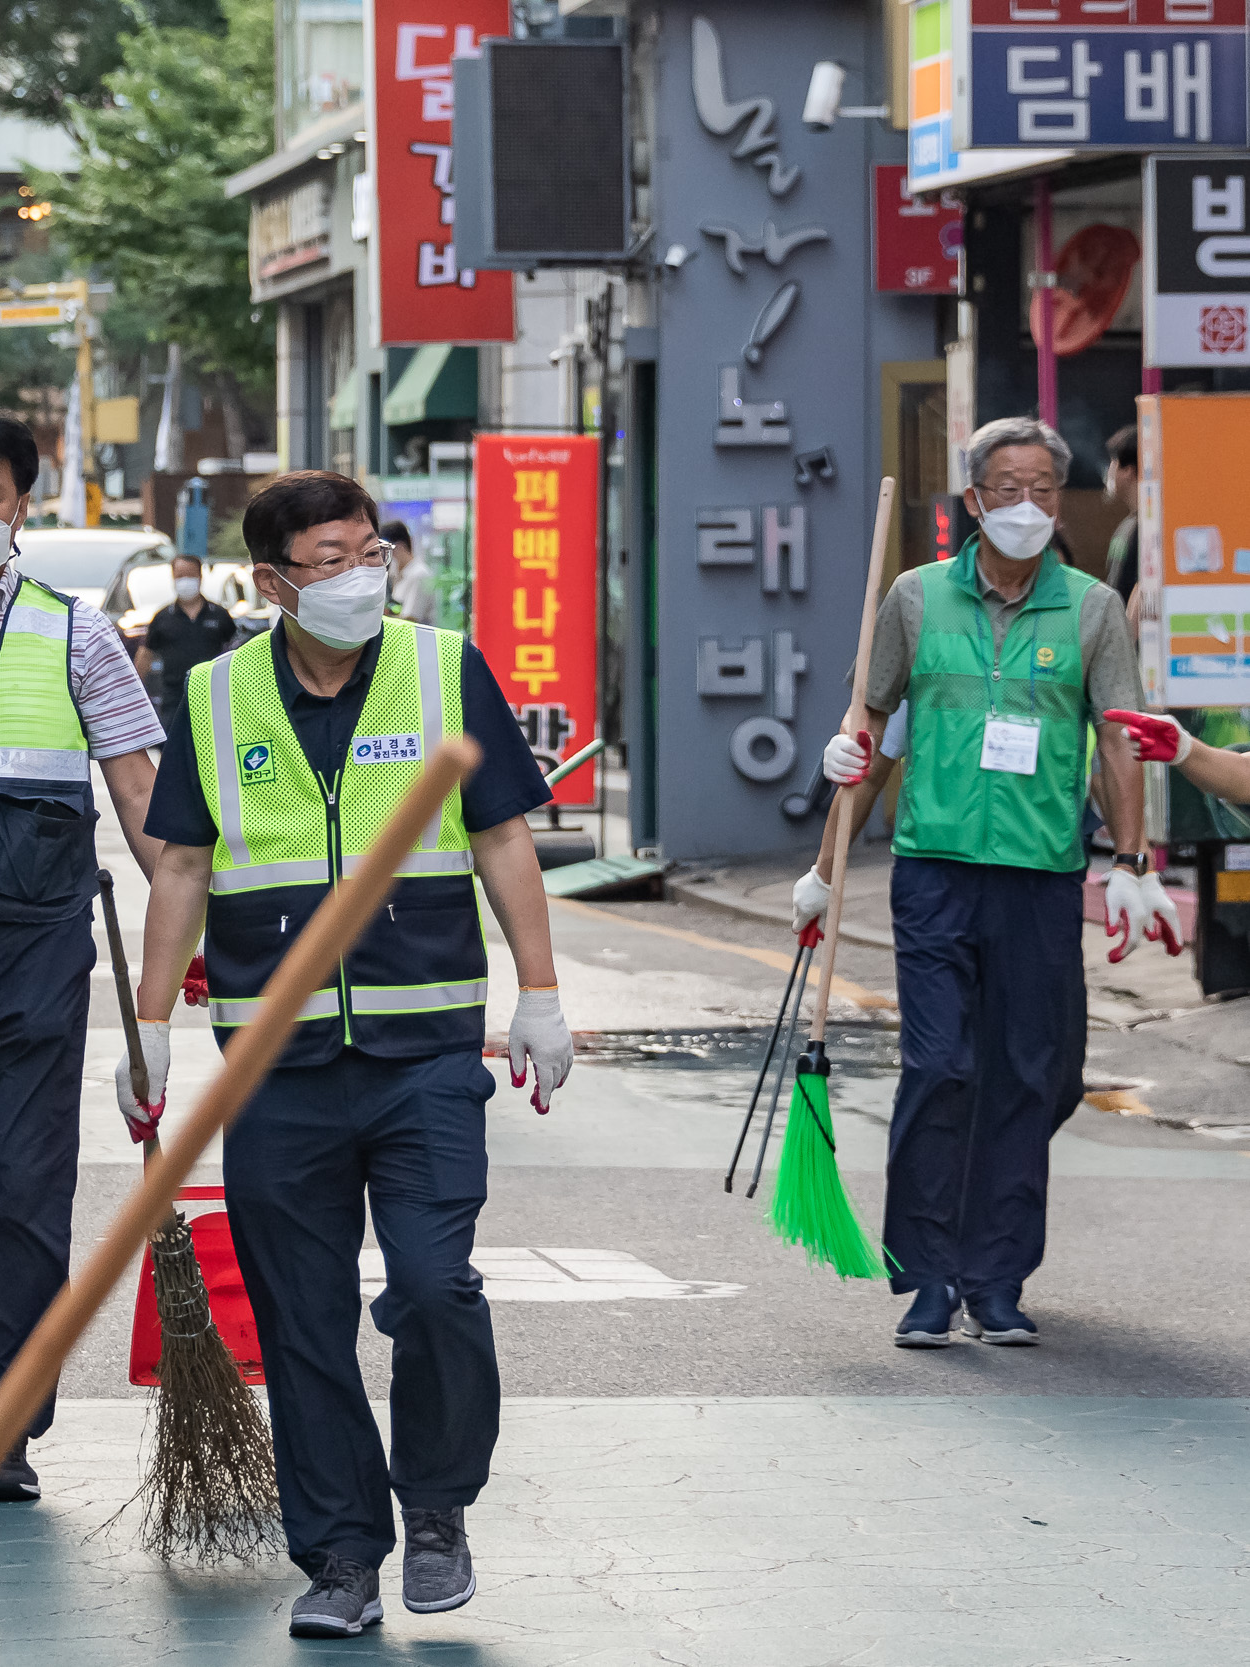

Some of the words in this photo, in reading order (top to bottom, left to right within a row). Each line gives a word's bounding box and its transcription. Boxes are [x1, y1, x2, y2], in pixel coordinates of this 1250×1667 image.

[1006, 39, 1213, 142] 담배
[510, 470, 561, 696] 편백나무
[243, 769, 272, 781] 광진구
[372, 748, 418, 760] 광진구청장
